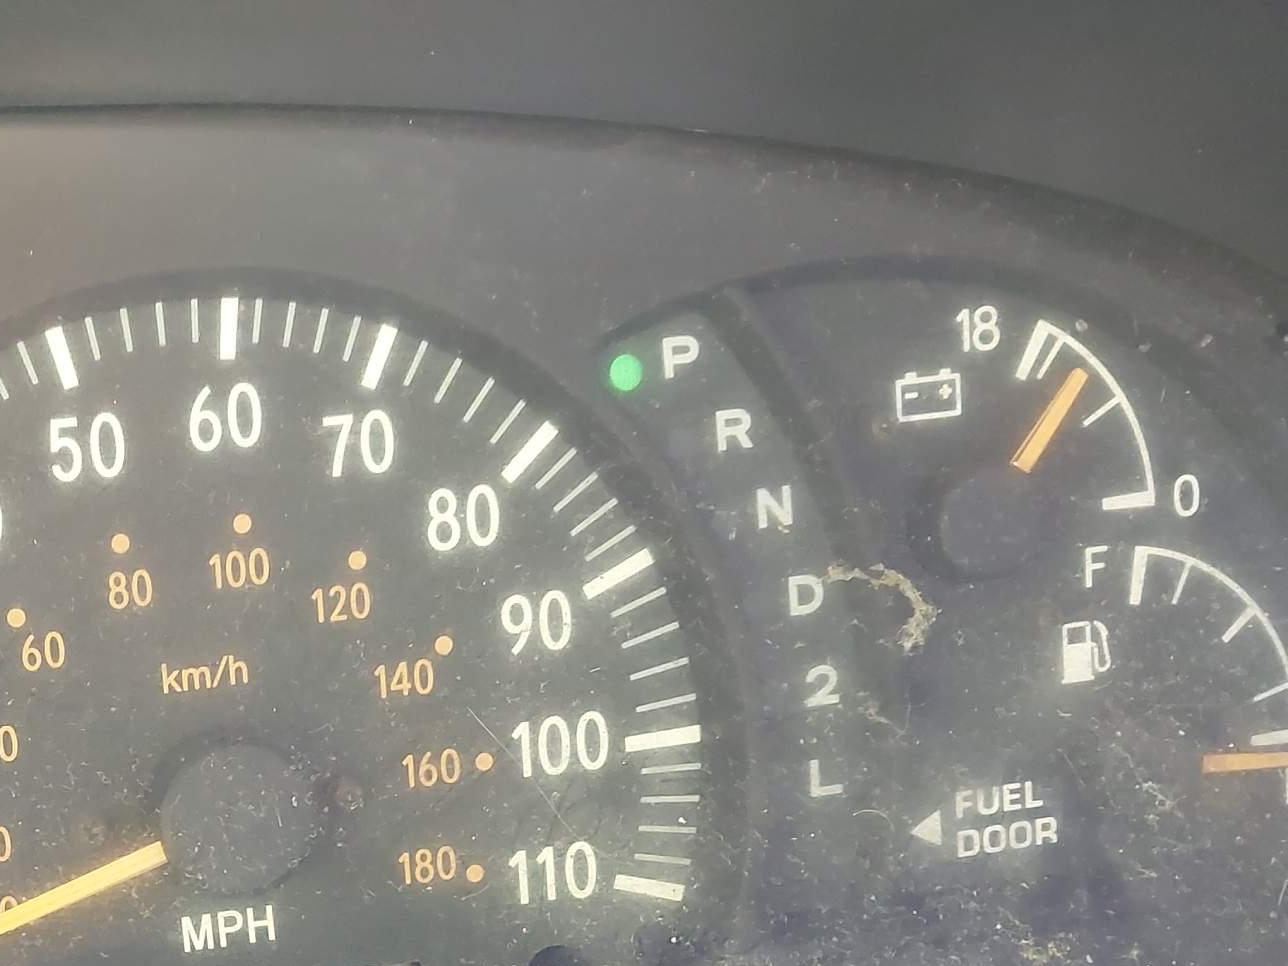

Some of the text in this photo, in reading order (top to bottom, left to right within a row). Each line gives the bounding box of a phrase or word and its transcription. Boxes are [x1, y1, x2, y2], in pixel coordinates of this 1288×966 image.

[955, 304, 1001, 352] 18
[661, 335, 700, 380] P
[188, 381, 263, 452] 60
[715, 408, 753, 452] R
[48, 411, 125, 483] 50
[322, 409, 395, 478] 70
[755, 485, 793, 529] N
[1172, 474, 1201, 517] 0
[426, 484, 500, 552] 80
[209, 547, 270, 590] 100
[1084, 545, 1109, 588] F
[107, 568, 153, 610] 80
[311, 581, 372, 624] 120
[787, 574, 825, 617] D
[500, 589, 572, 656] 90
[21, 630, 66, 671] 60
[160, 654, 249, 694] km/h
[374, 657, 435, 699] 140
[803, 664, 841, 708] 2
[511, 709, 609, 779] 100
[401, 747, 462, 789] 160
[808, 759, 844, 798] L
[954, 780, 1044, 820] FUEL
[955, 816, 1059, 858] DOOR
[398, 845, 457, 885] 180
[508, 841, 596, 904] 110
[180, 904, 277, 954] MPH
